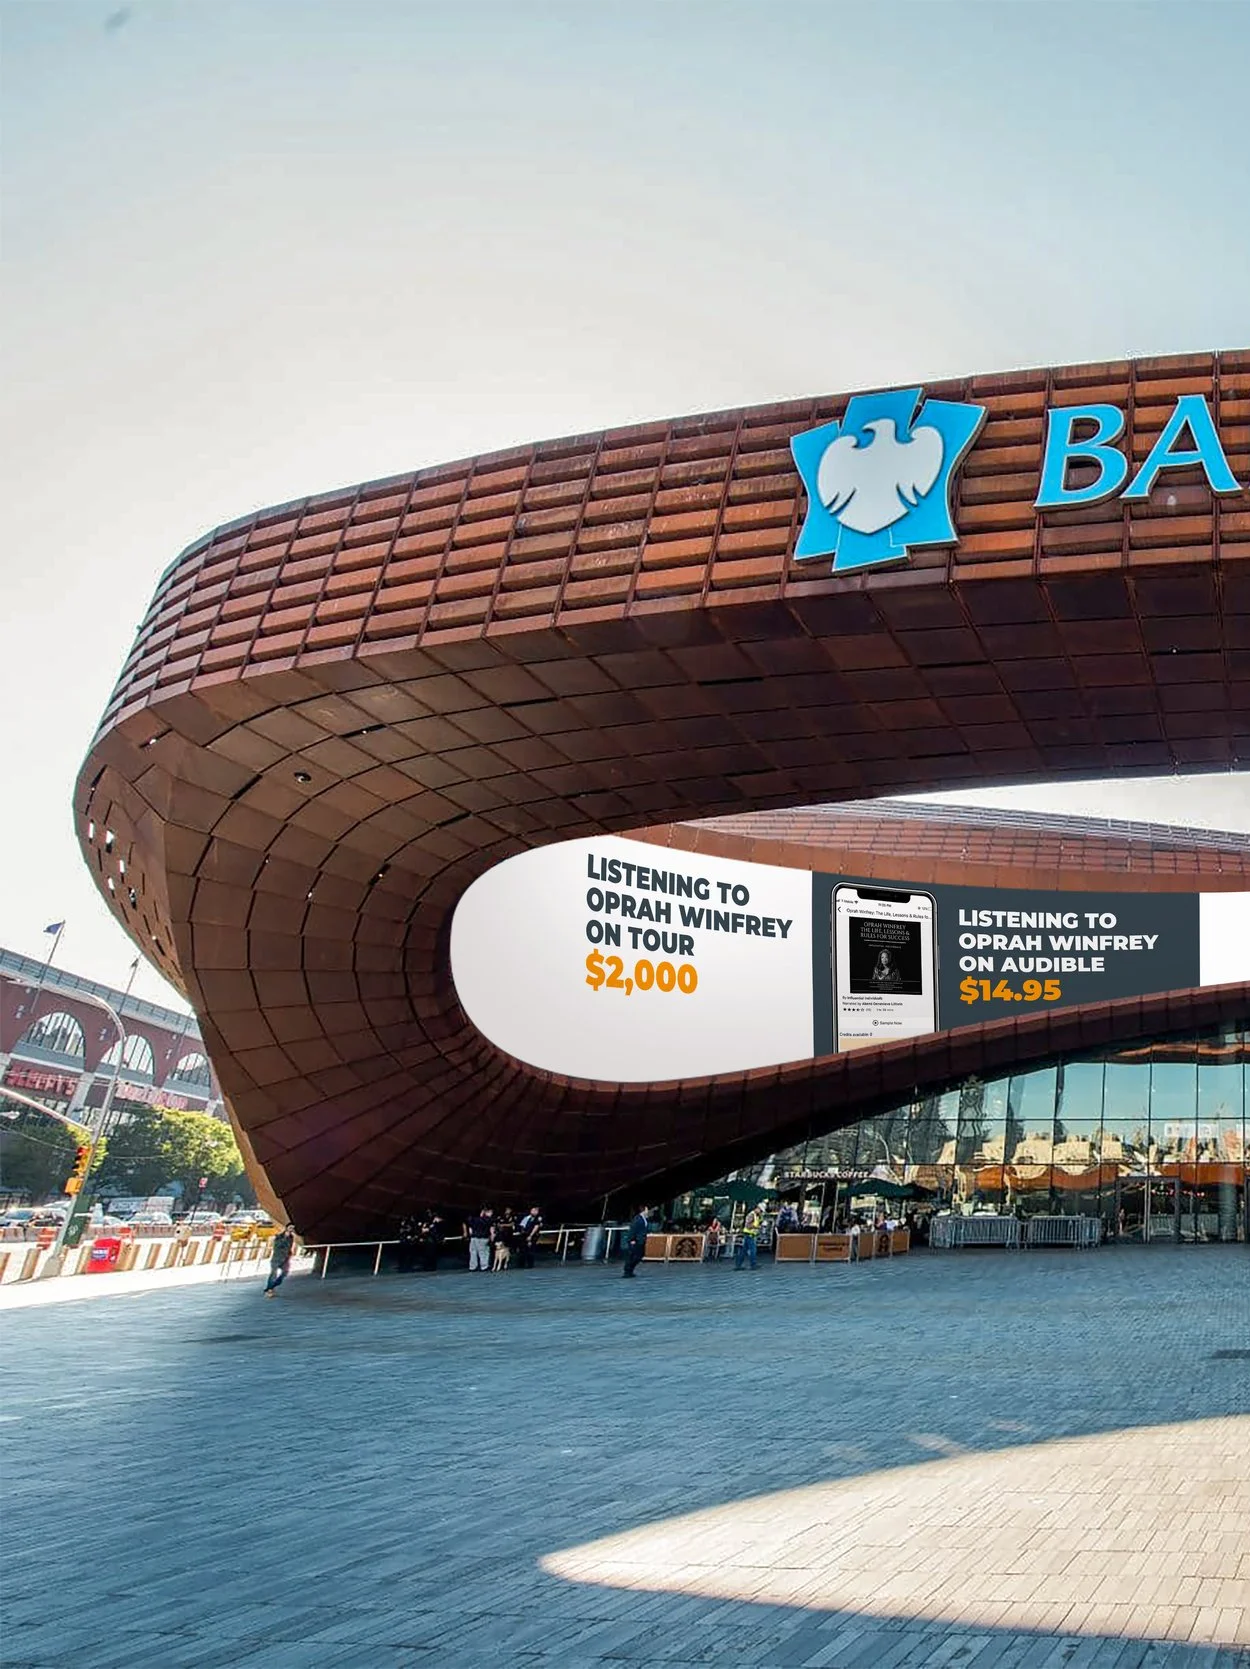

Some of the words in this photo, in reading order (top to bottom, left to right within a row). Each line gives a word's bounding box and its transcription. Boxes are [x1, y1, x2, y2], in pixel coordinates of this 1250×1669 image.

[587, 853, 711, 901] LISTENING
[716, 881, 750, 907] TO
[586, 887, 672, 925] OPRAH
[679, 904, 793, 939] WINFREY
[958, 908, 1079, 929] LISTENING
[1084, 912, 1117, 929] TO
[586, 919, 621, 948] ON
[628, 925, 695, 957] TOUR
[958, 932, 1042, 951] OPRAH
[1049, 934, 1159, 951] WINFREY
[585, 948, 698, 996] $2,000
[959, 955, 994, 972] ON
[1000, 956, 1105, 973] AUDIBLE
[959, 975, 1062, 1005] $14.95
[837, 1170, 869, 1179] COFFEE
